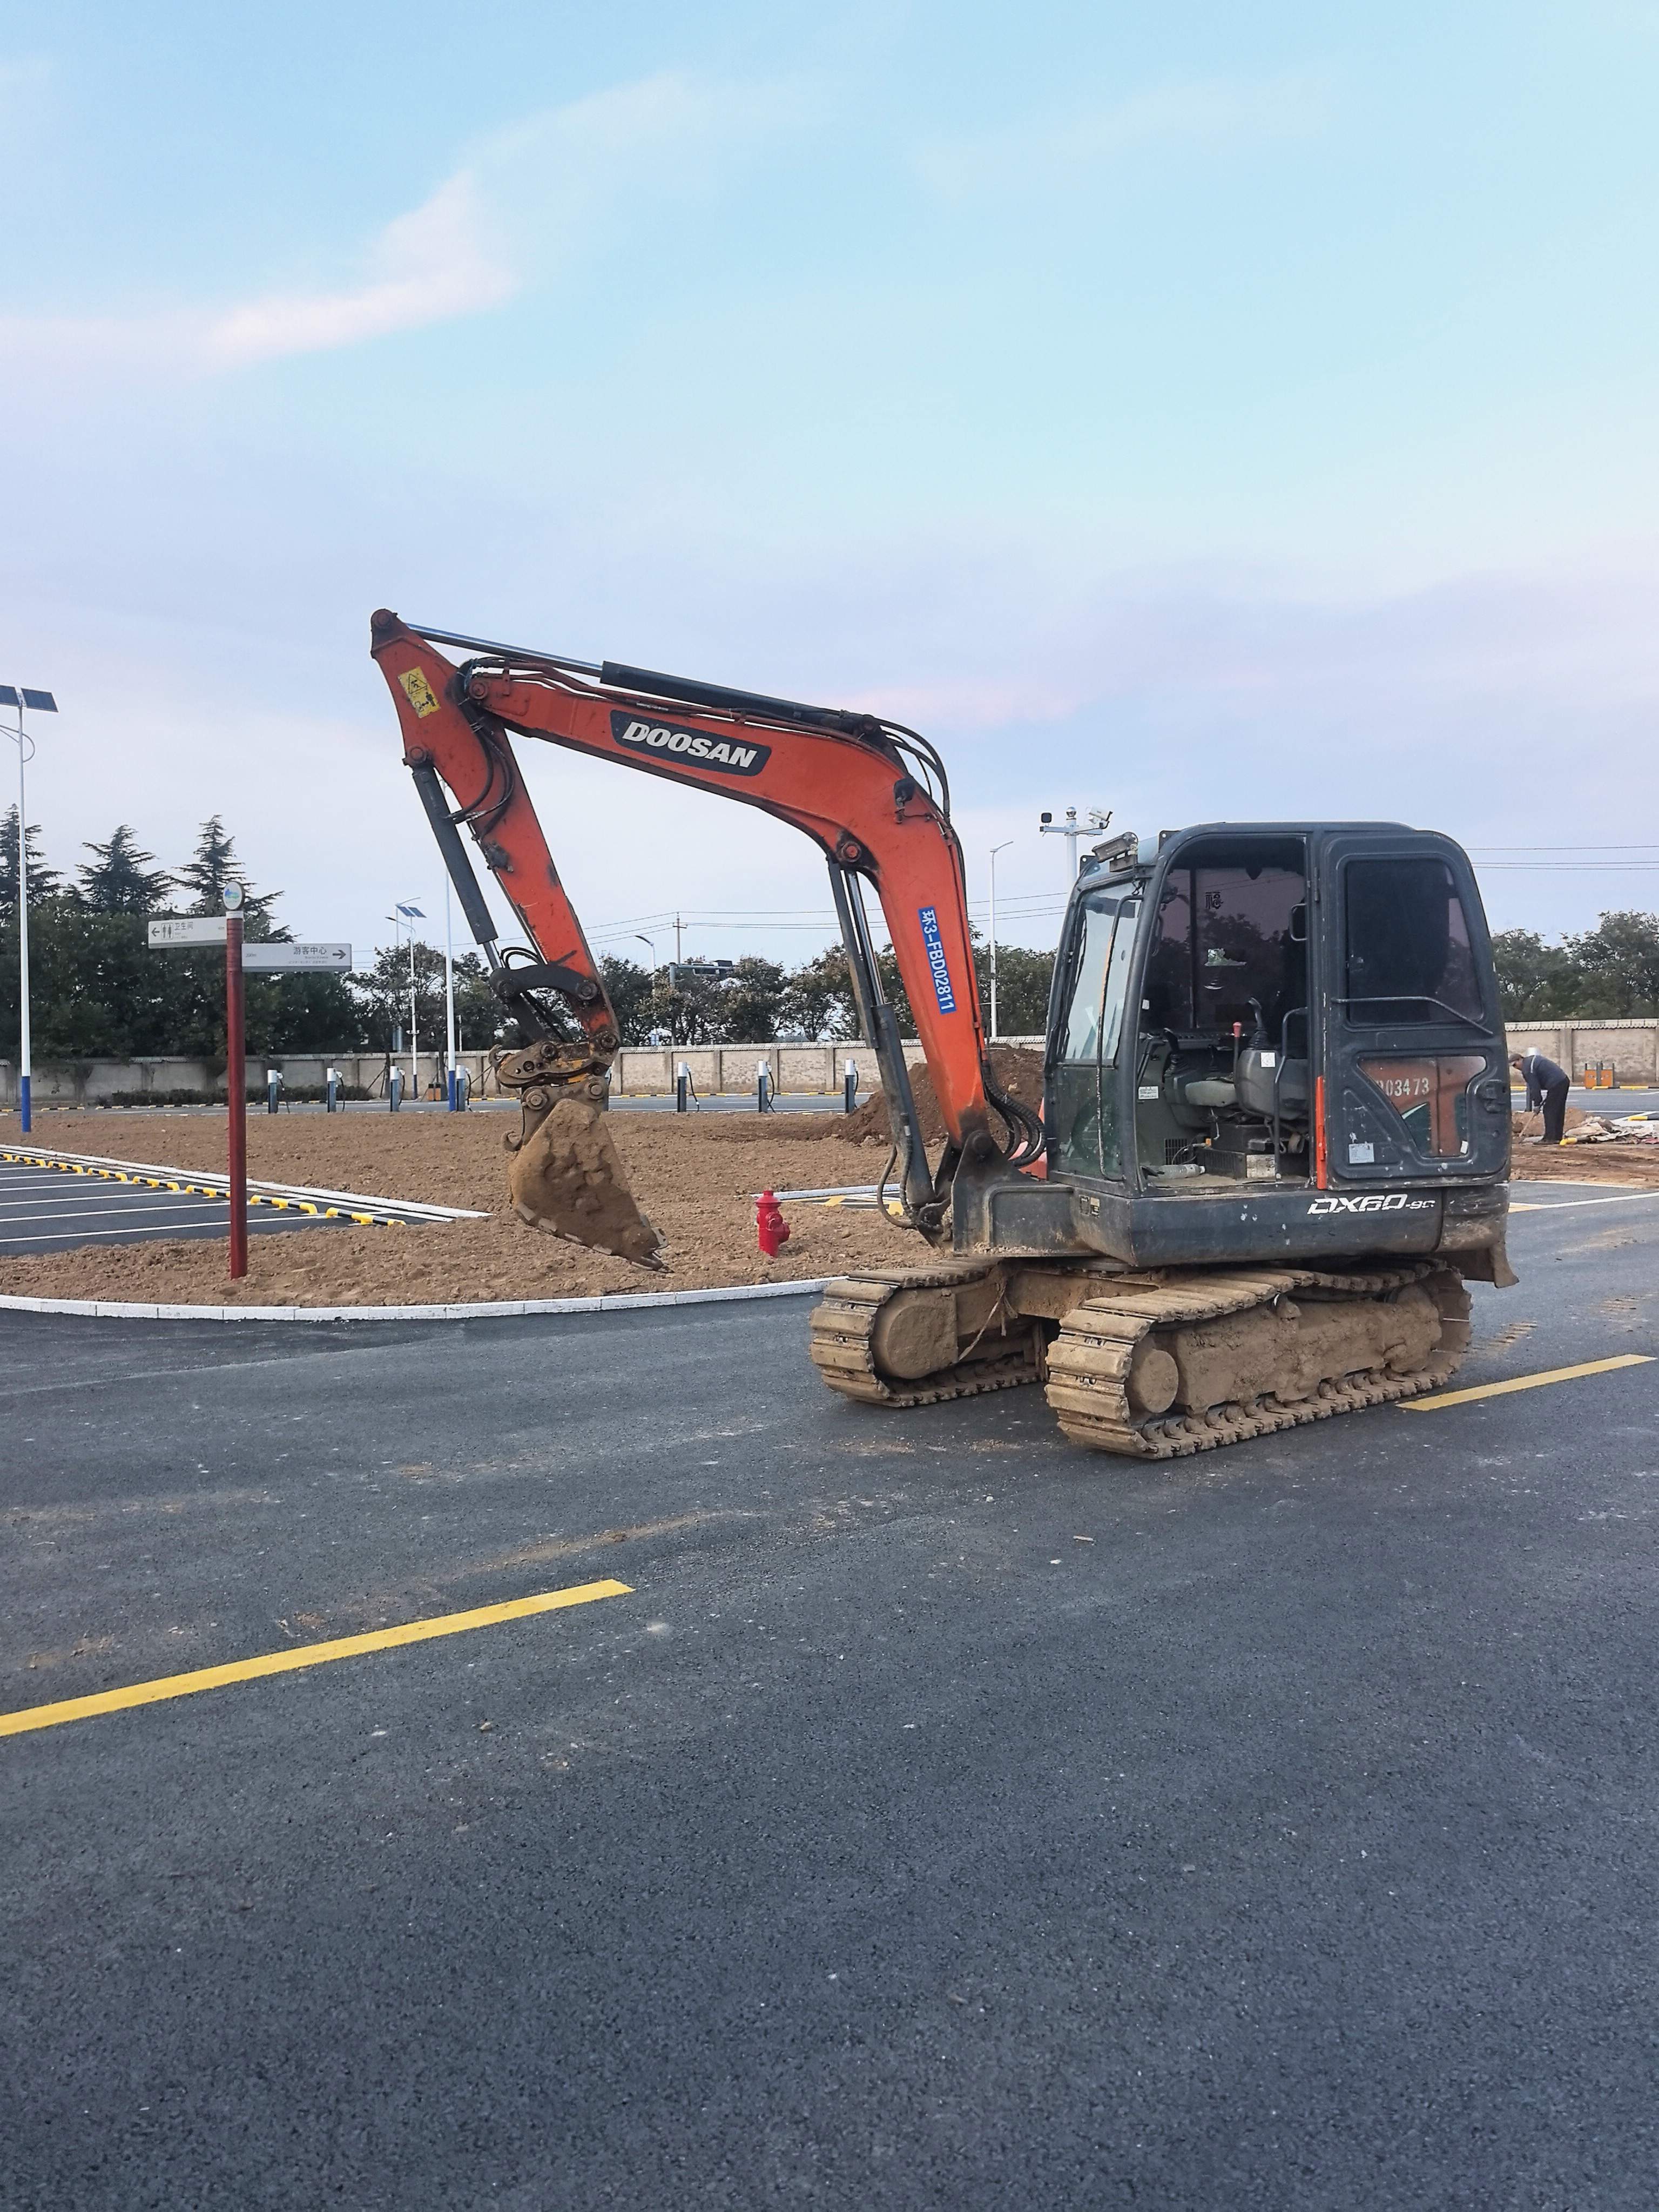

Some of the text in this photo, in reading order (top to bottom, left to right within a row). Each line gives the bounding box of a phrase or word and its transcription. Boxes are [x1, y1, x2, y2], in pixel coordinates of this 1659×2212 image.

[622, 721, 757, 768] DOOSAN
[174, 921, 193, 930] 卫生间
[293, 946, 327, 955] 游客中心
[921, 909, 955, 1010] 环3-FBD02811
